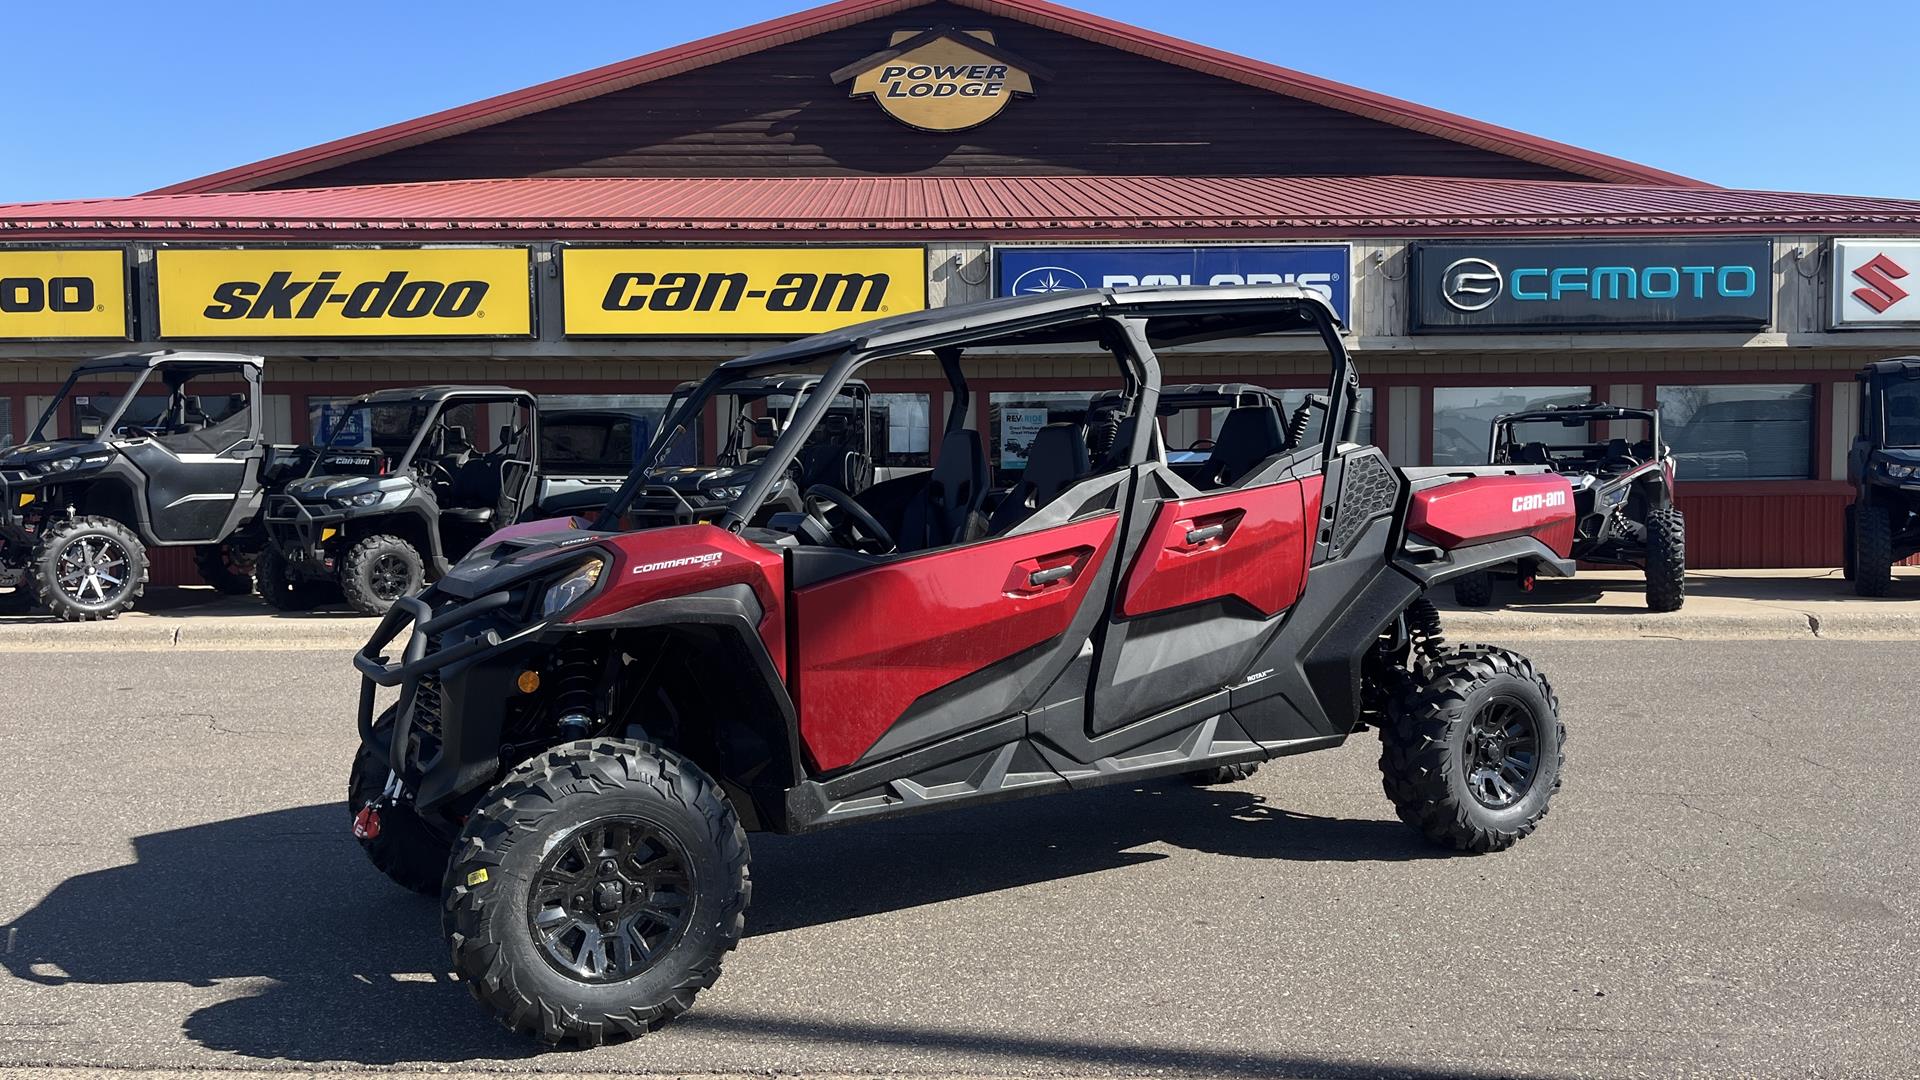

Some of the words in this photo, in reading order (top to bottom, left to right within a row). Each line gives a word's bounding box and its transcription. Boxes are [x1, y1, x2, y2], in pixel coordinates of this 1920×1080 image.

[880, 64, 1008, 84] POWER
[886, 82, 1004, 98] LODGE
[601, 272, 890, 312] can-am
[1510, 265, 1756, 301] CFMOTO
[203, 271, 490, 319] ski-doo
[335, 458, 370, 466] can-am
[1511, 490, 1566, 513] can-am
[633, 552, 723, 574] COMMANDER
[700, 559, 722, 569] XT
[1246, 671, 1268, 682] ROTAX
